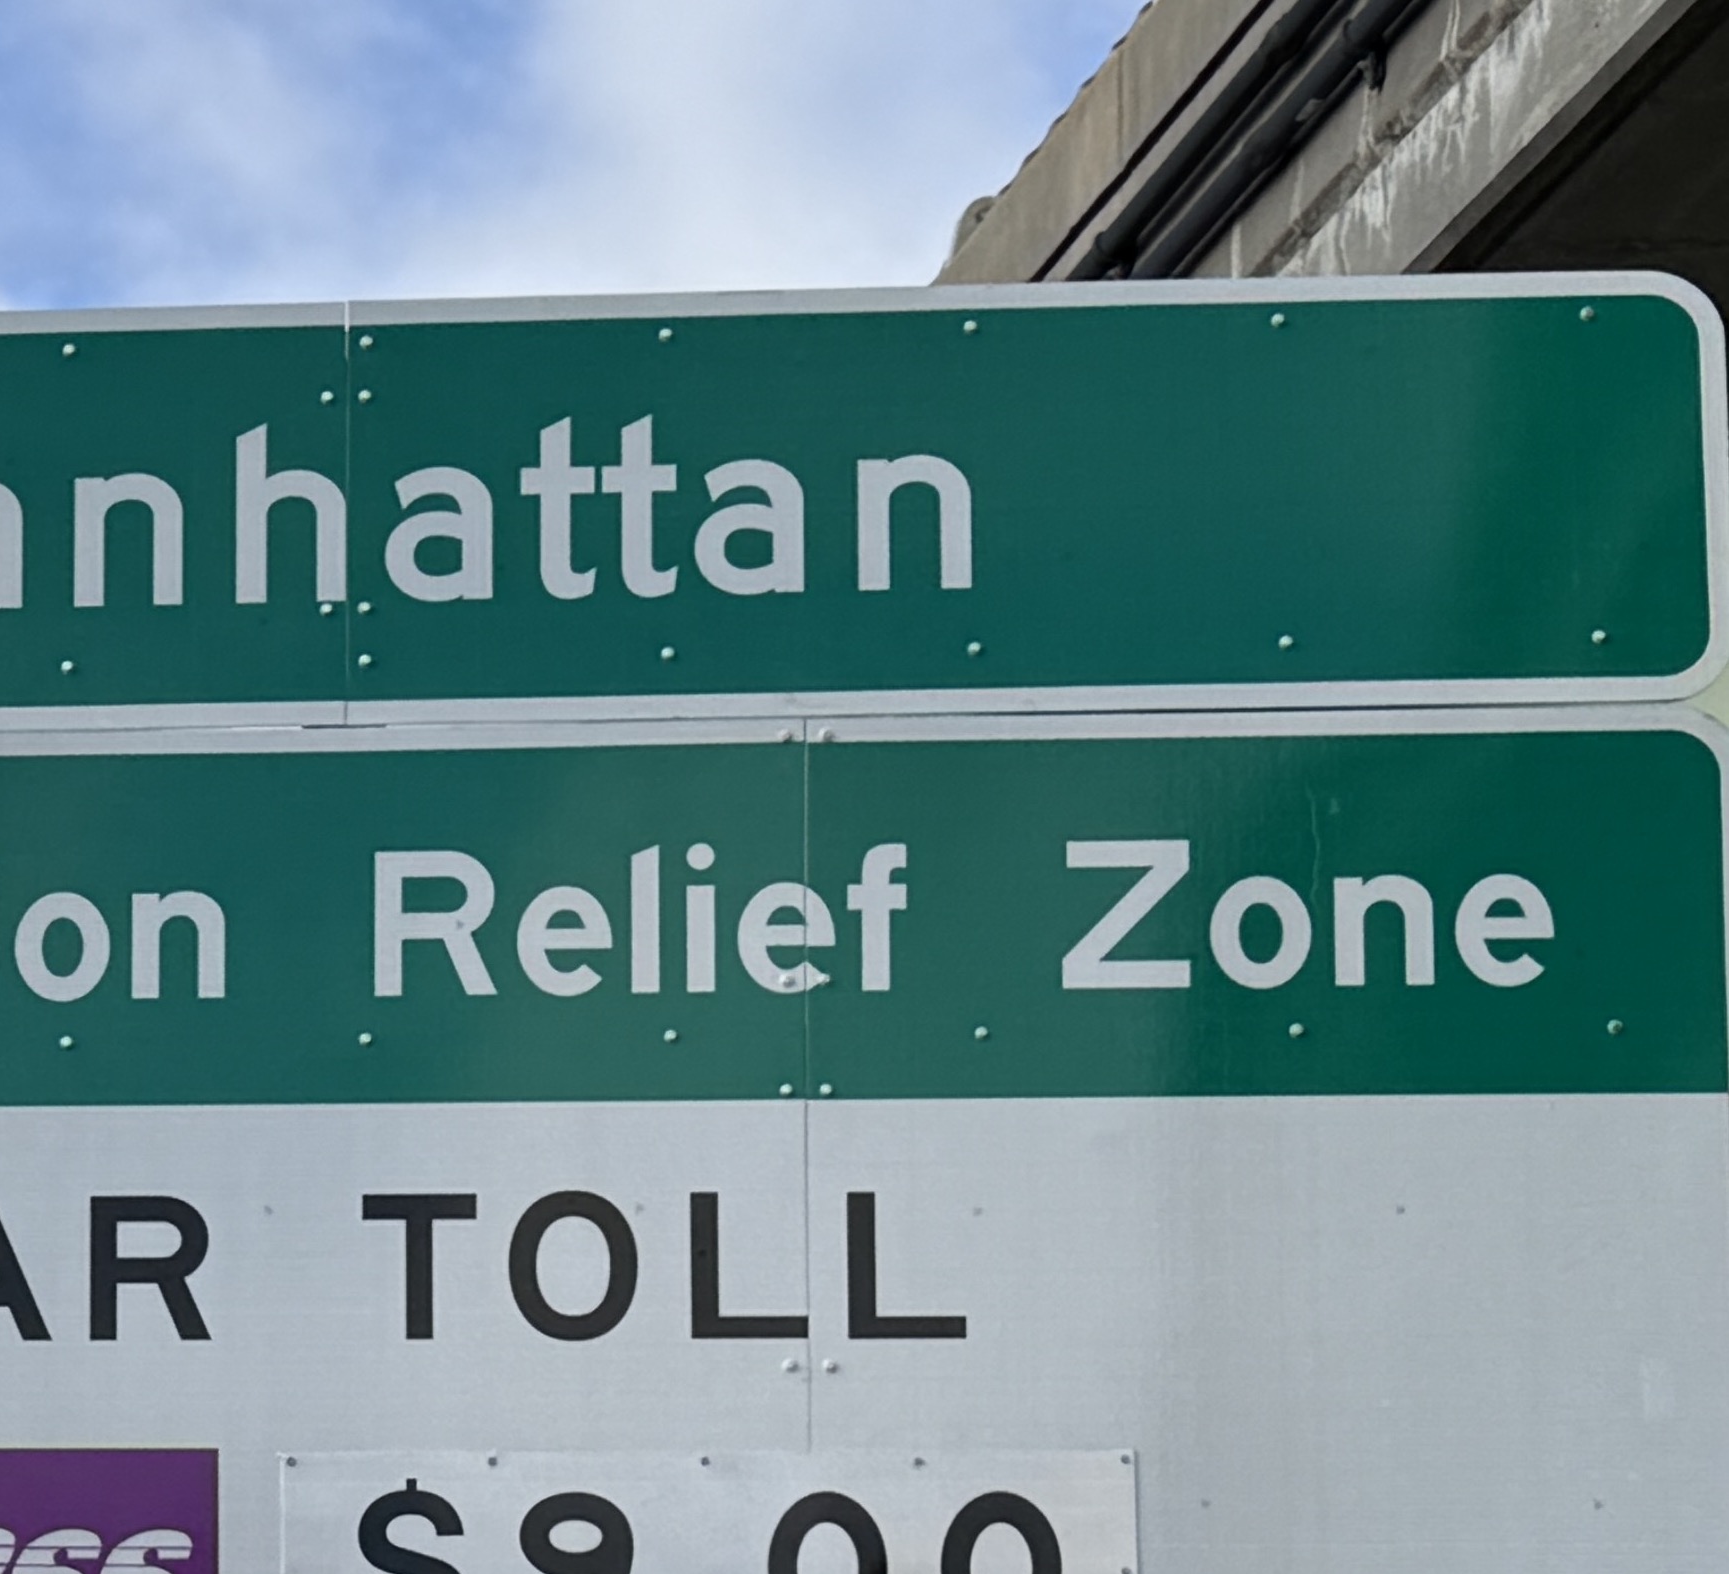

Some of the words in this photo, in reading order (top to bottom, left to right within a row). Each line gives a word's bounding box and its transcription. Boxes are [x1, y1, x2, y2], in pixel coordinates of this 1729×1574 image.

[375, 844, 906, 996] Relief
[1062, 840, 1554, 988] Zone
[363, 1191, 966, 1340] TOLL
